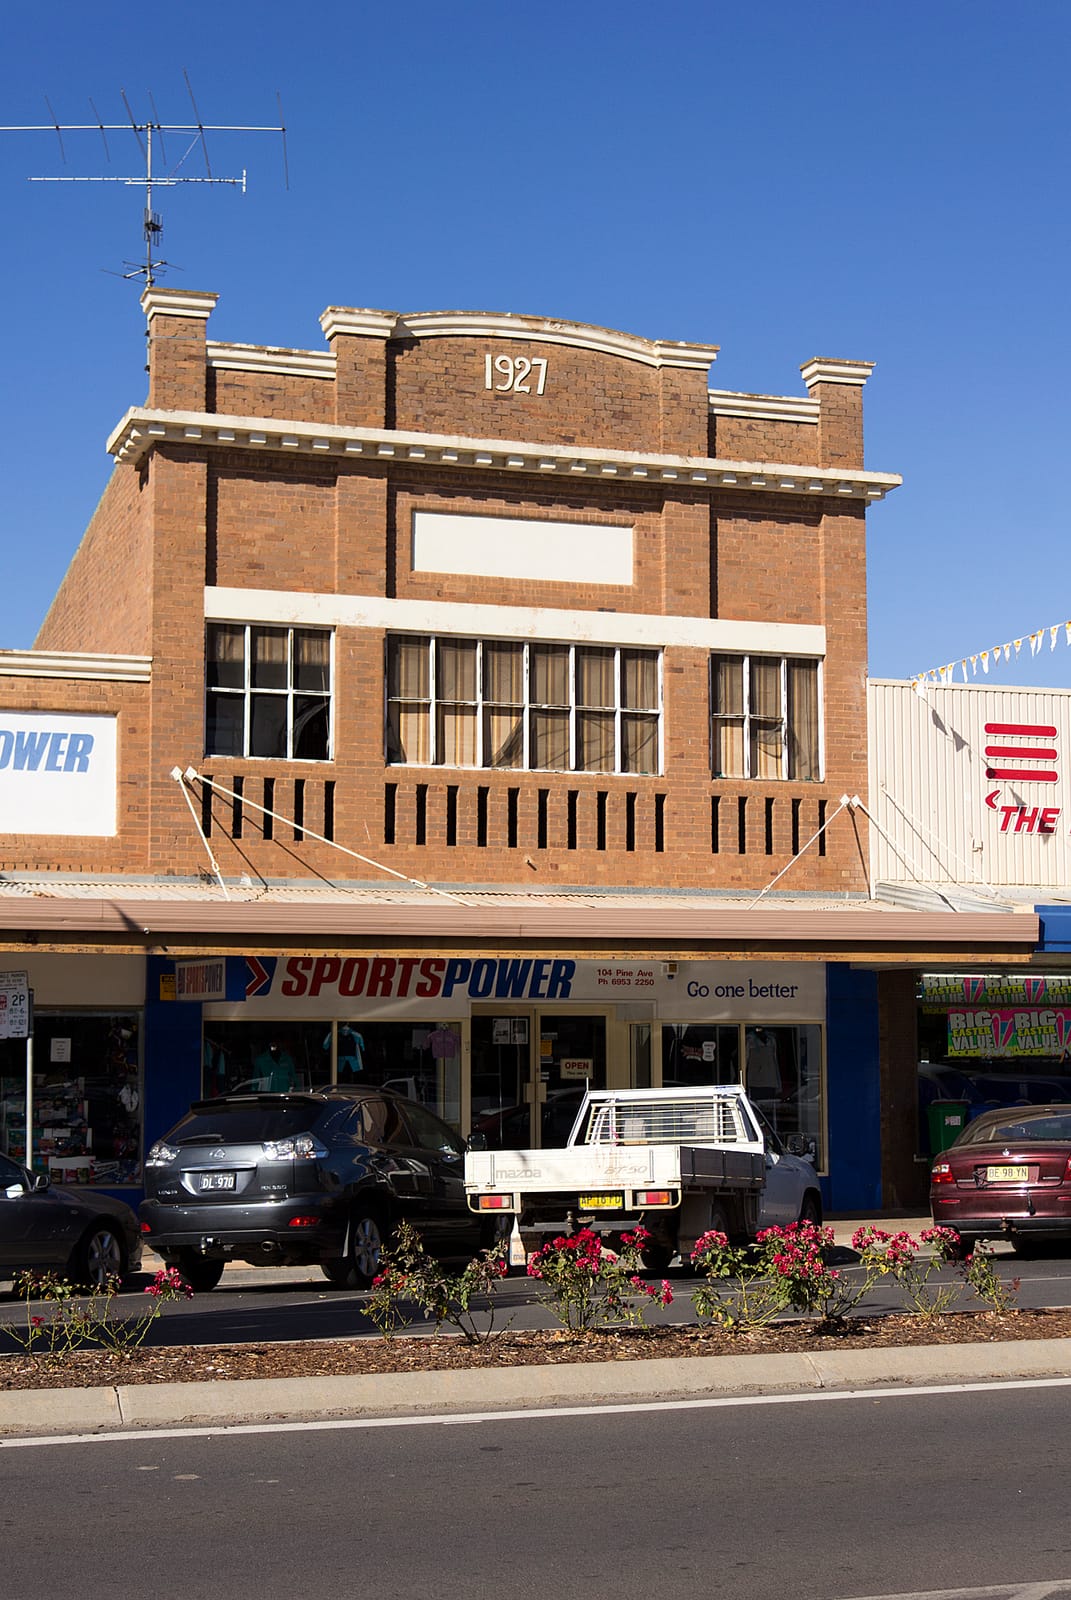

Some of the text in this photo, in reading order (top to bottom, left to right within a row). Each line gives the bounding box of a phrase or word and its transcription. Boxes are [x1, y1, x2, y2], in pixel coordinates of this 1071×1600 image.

[485, 354, 548, 395] 1927
[1000, 806, 1060, 834] THE
[281, 957, 576, 998] SPORTSPOWER
[597, 969, 612, 977] 104
[616, 969, 633, 977] Pine
[687, 978, 798, 998] Go one better
[924, 977, 964, 989] BIG
[926, 985, 963, 996] EASTER
[987, 985, 1025, 996] EASTER
[12, 994, 26, 1006] 2P
[949, 1011, 993, 1031] BIG
[1014, 1010, 1057, 1030] BIG
[952, 1026, 991, 1037] EASTER
[1016, 1025, 1056, 1037] EASTER
[951, 1034, 994, 1051] VALUE
[1016, 1034, 1059, 1050] VALUE
[565, 1062, 589, 1070] OPEN
[217, 1176, 234, 1188] 970
